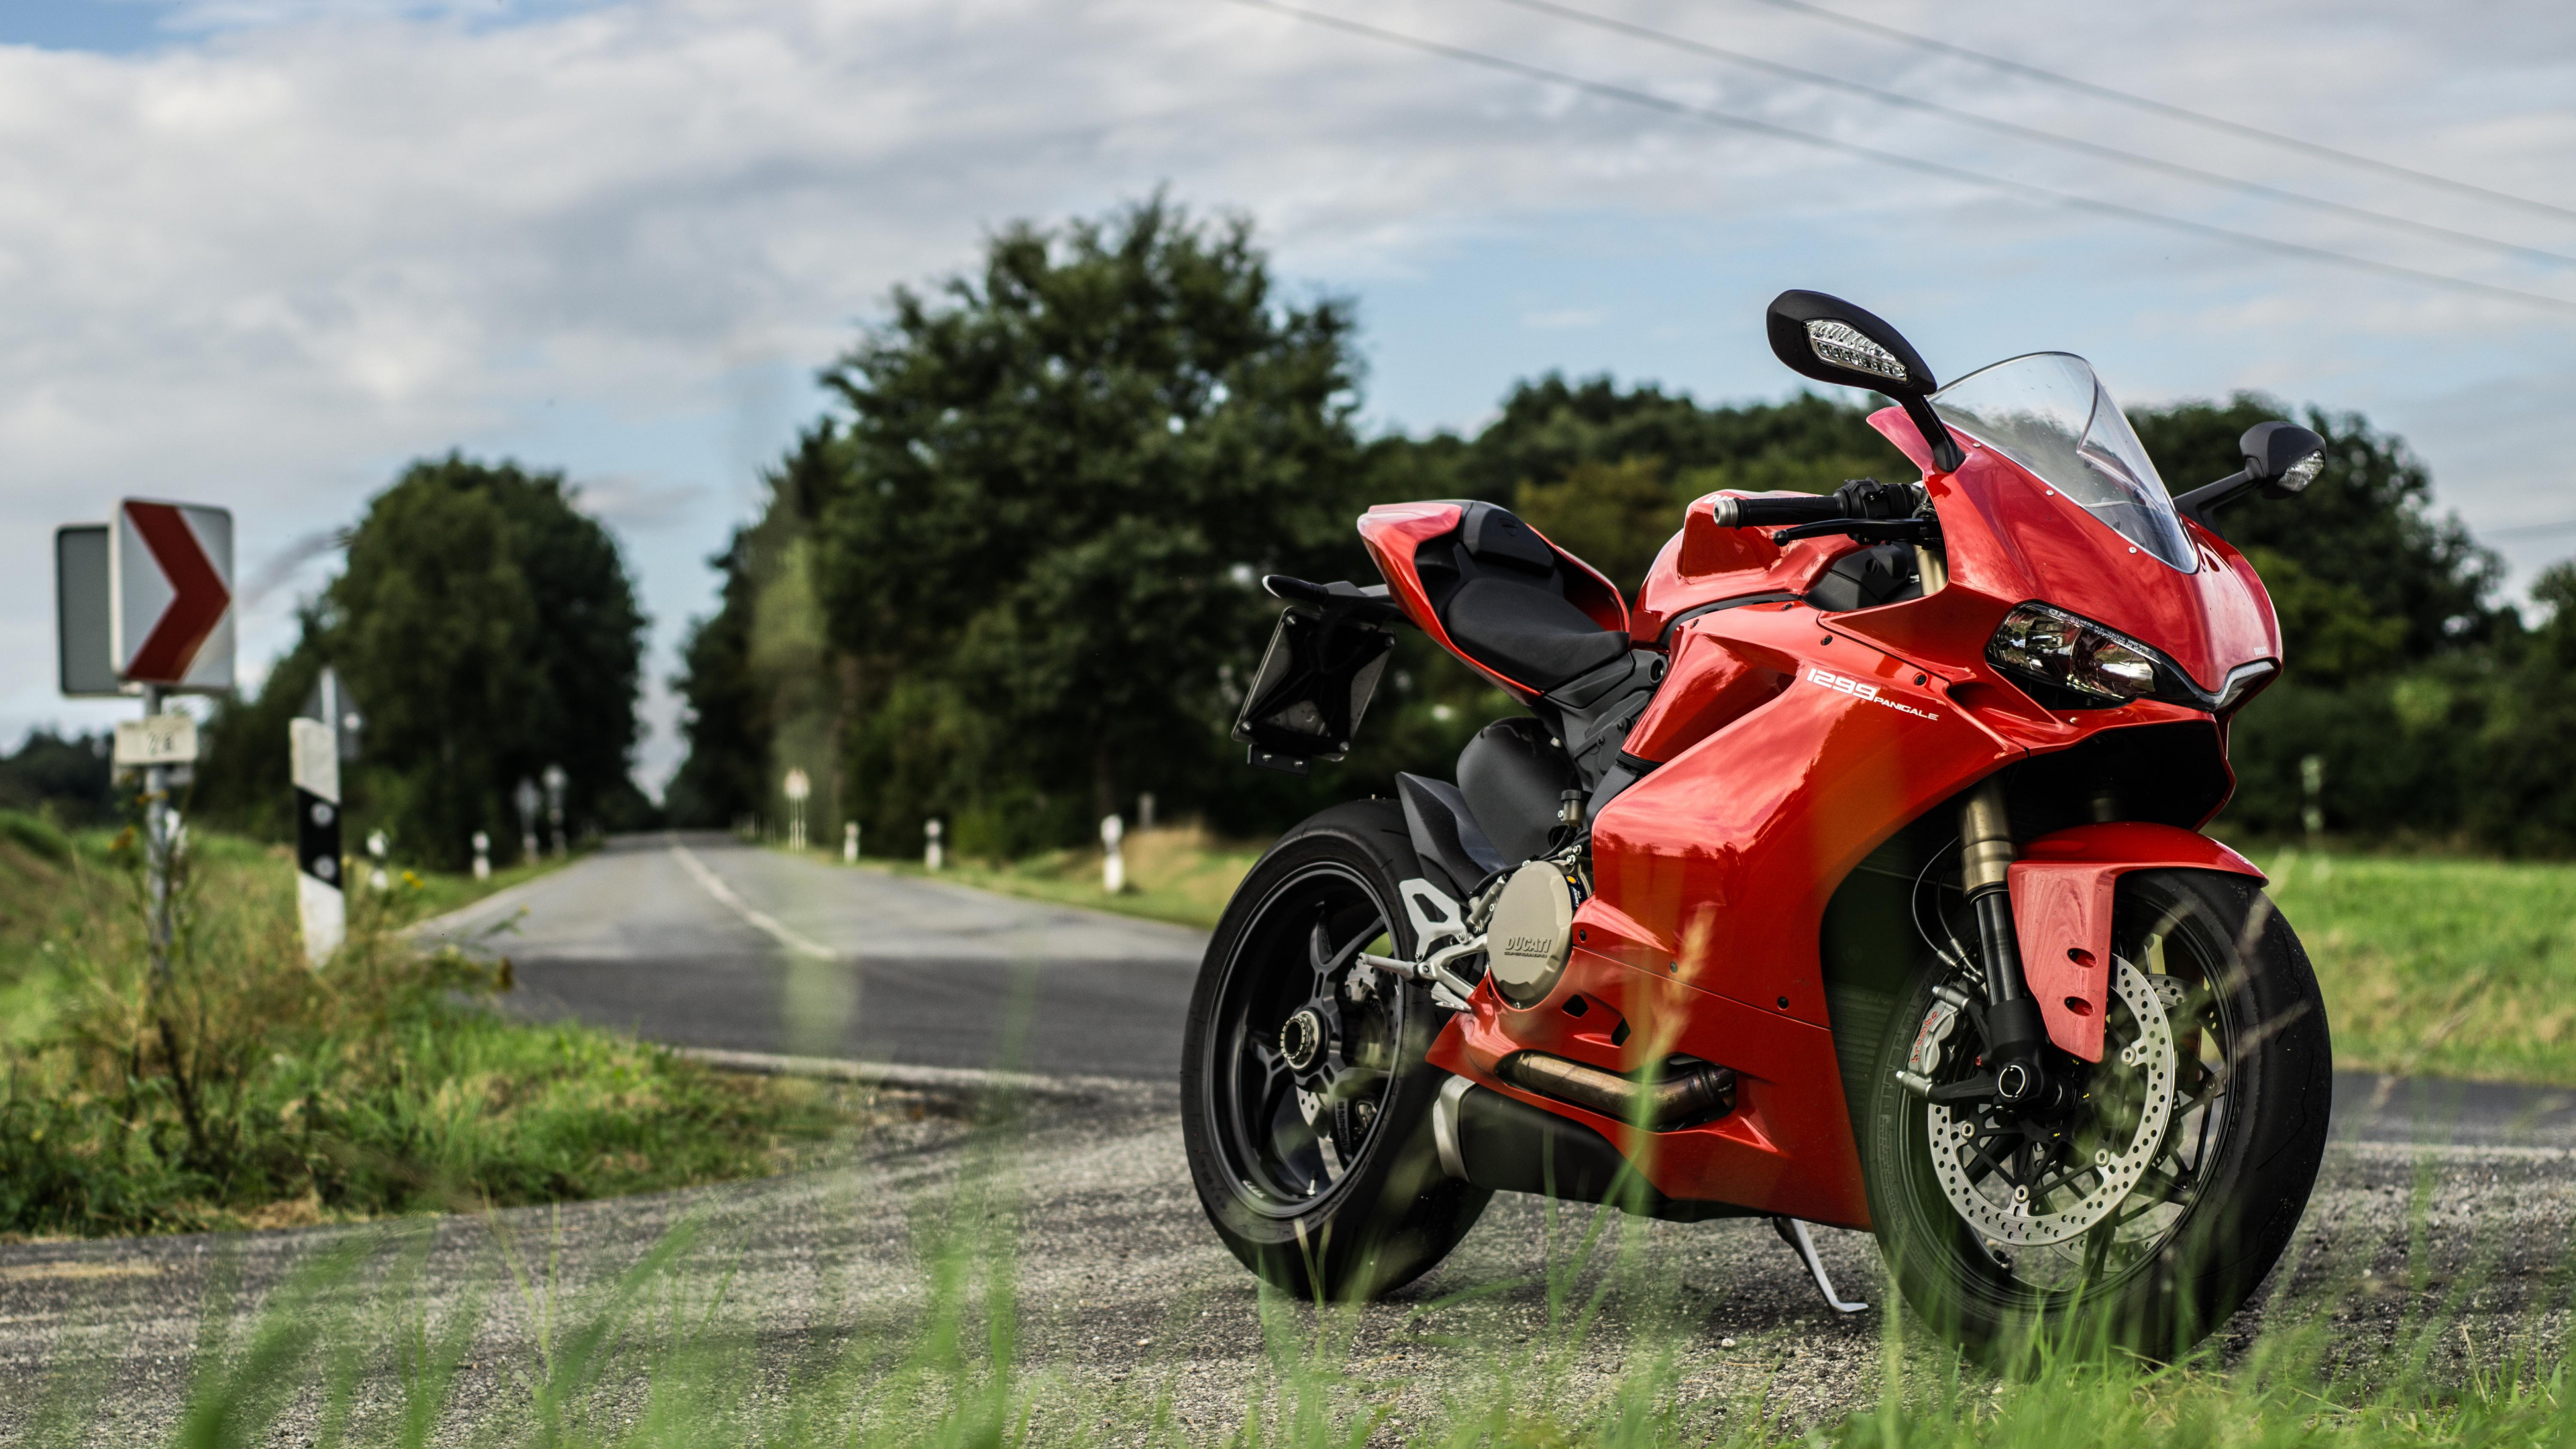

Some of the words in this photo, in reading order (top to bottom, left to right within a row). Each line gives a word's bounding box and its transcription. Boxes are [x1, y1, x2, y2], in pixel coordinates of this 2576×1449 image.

[1807, 667, 1878, 701] 1299
[1874, 696, 1939, 721] PANIGALE
[1505, 936, 1552, 953] DUCATI
[1911, 1011, 1938, 1063] brembo
